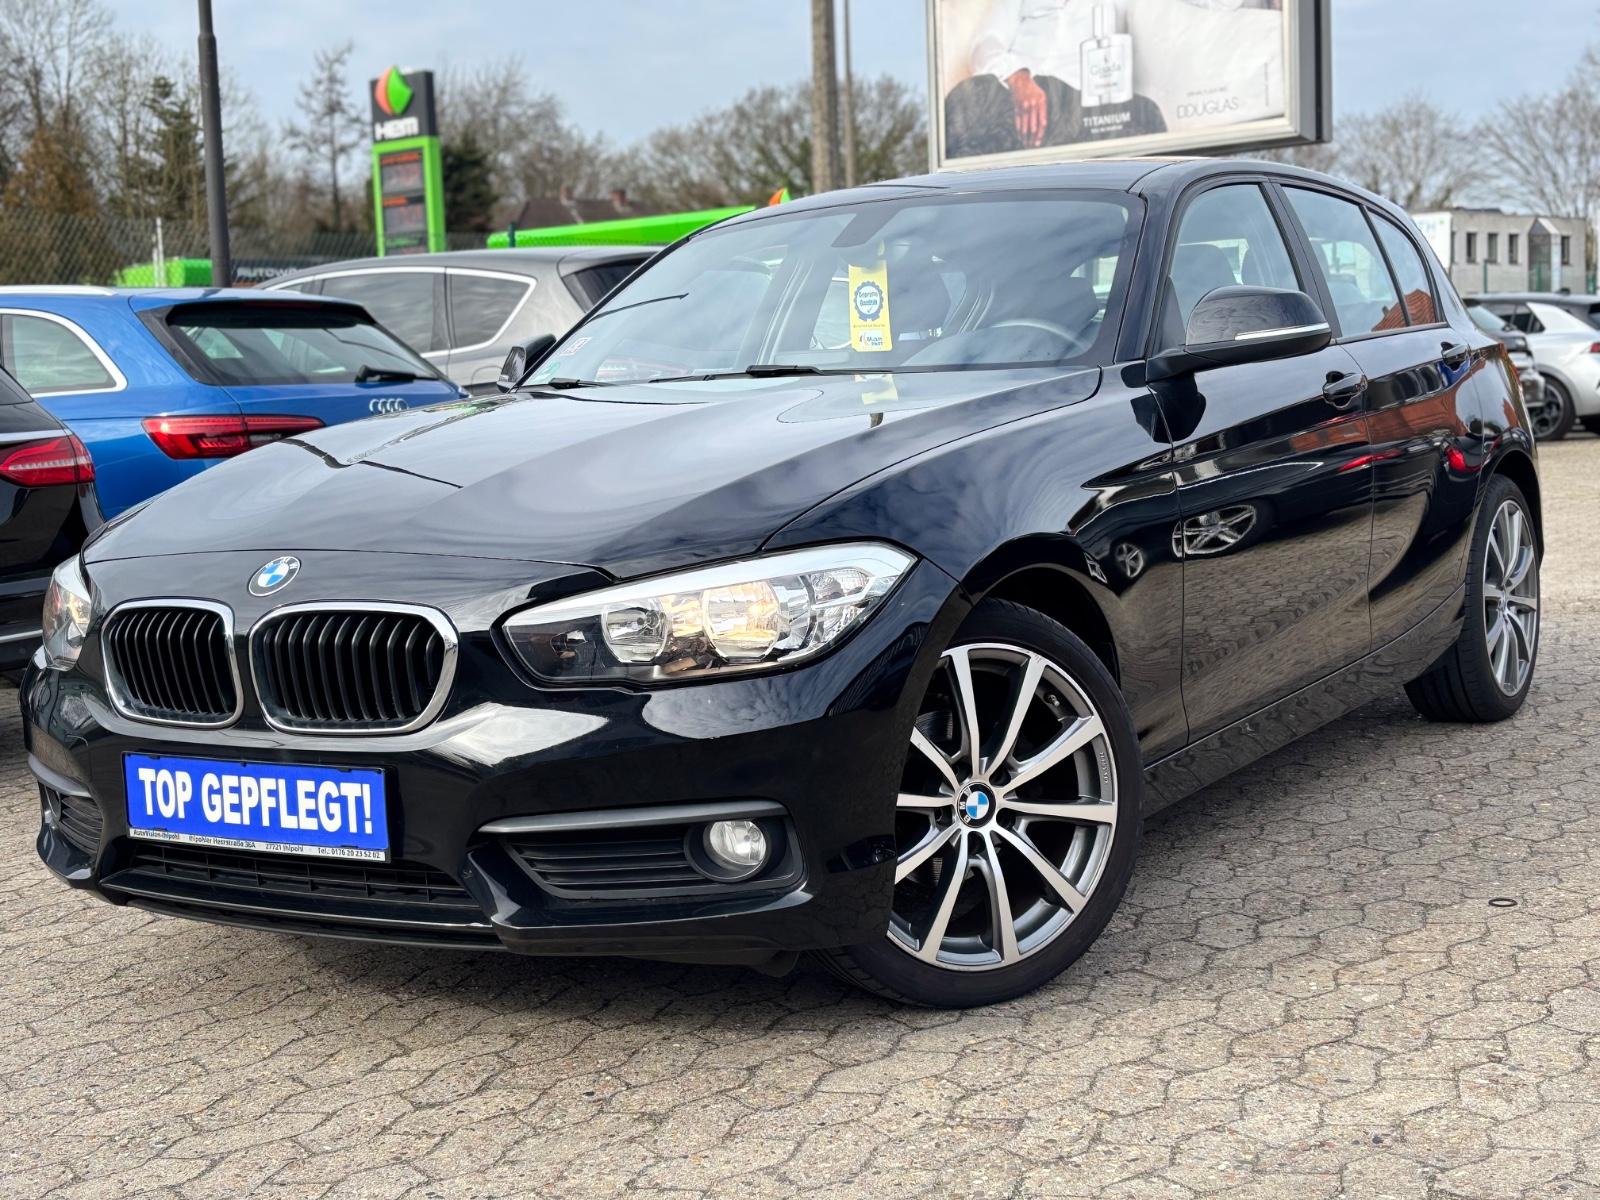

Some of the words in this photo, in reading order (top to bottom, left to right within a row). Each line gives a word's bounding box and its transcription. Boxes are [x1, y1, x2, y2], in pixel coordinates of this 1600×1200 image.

[1083, 111, 1131, 127] TITANIUM
[1176, 97, 1239, 119] DOUGLAS
[374, 116, 419, 140] HEM
[138, 767, 193, 819] TOP
[201, 772, 373, 834] GEPFLEGT!
